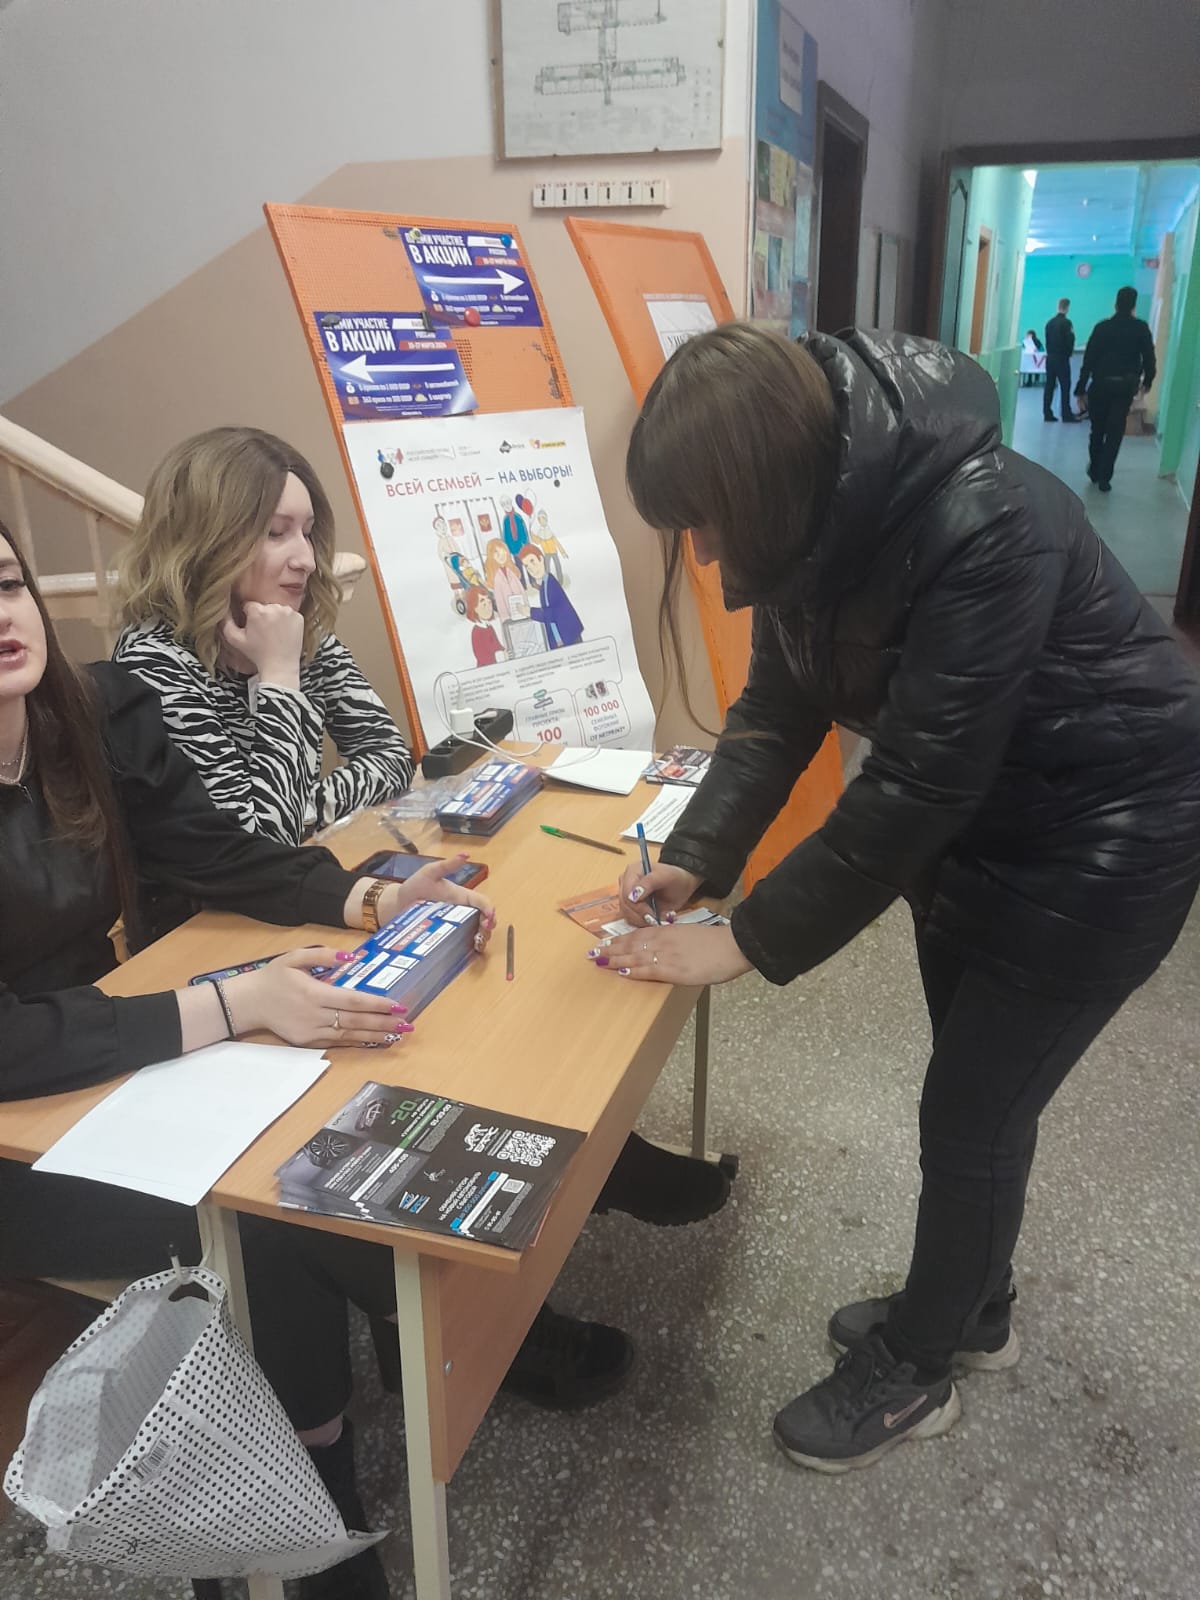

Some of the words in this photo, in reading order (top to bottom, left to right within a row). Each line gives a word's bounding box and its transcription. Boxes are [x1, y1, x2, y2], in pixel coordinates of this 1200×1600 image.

[408, 245, 423, 264] В
[423, 245, 472, 267] АКЦИИ
[352, 318, 391, 330] УЧАСТИЕ
[325, 331, 340, 352] В
[341, 331, 396, 354] АКЦИИ
[385, 478, 424, 498] ВСЕЙ
[427, 473, 482, 492] СЕМЬЕЙ
[498, 471, 517, 484] НА
[519, 464, 574, 482] ВЫБОРЫ!
[583, 704, 600, 717] 100
[601, 699, 620, 712] 000
[537, 726, 562, 743] 100
